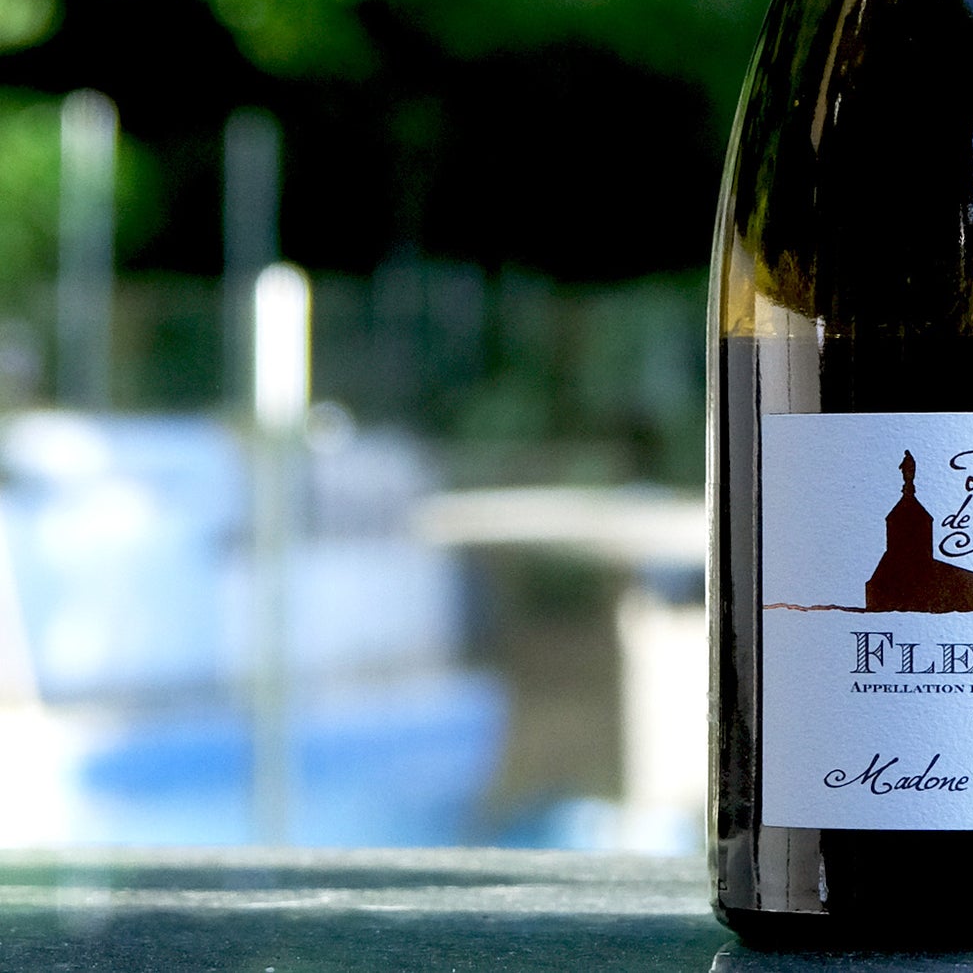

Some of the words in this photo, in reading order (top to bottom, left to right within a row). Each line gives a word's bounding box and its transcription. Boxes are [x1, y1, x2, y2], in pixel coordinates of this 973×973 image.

[941, 493, 971, 529] de
[850, 680, 965, 694] APPELLATION
[822, 752, 970, 796] Madone
